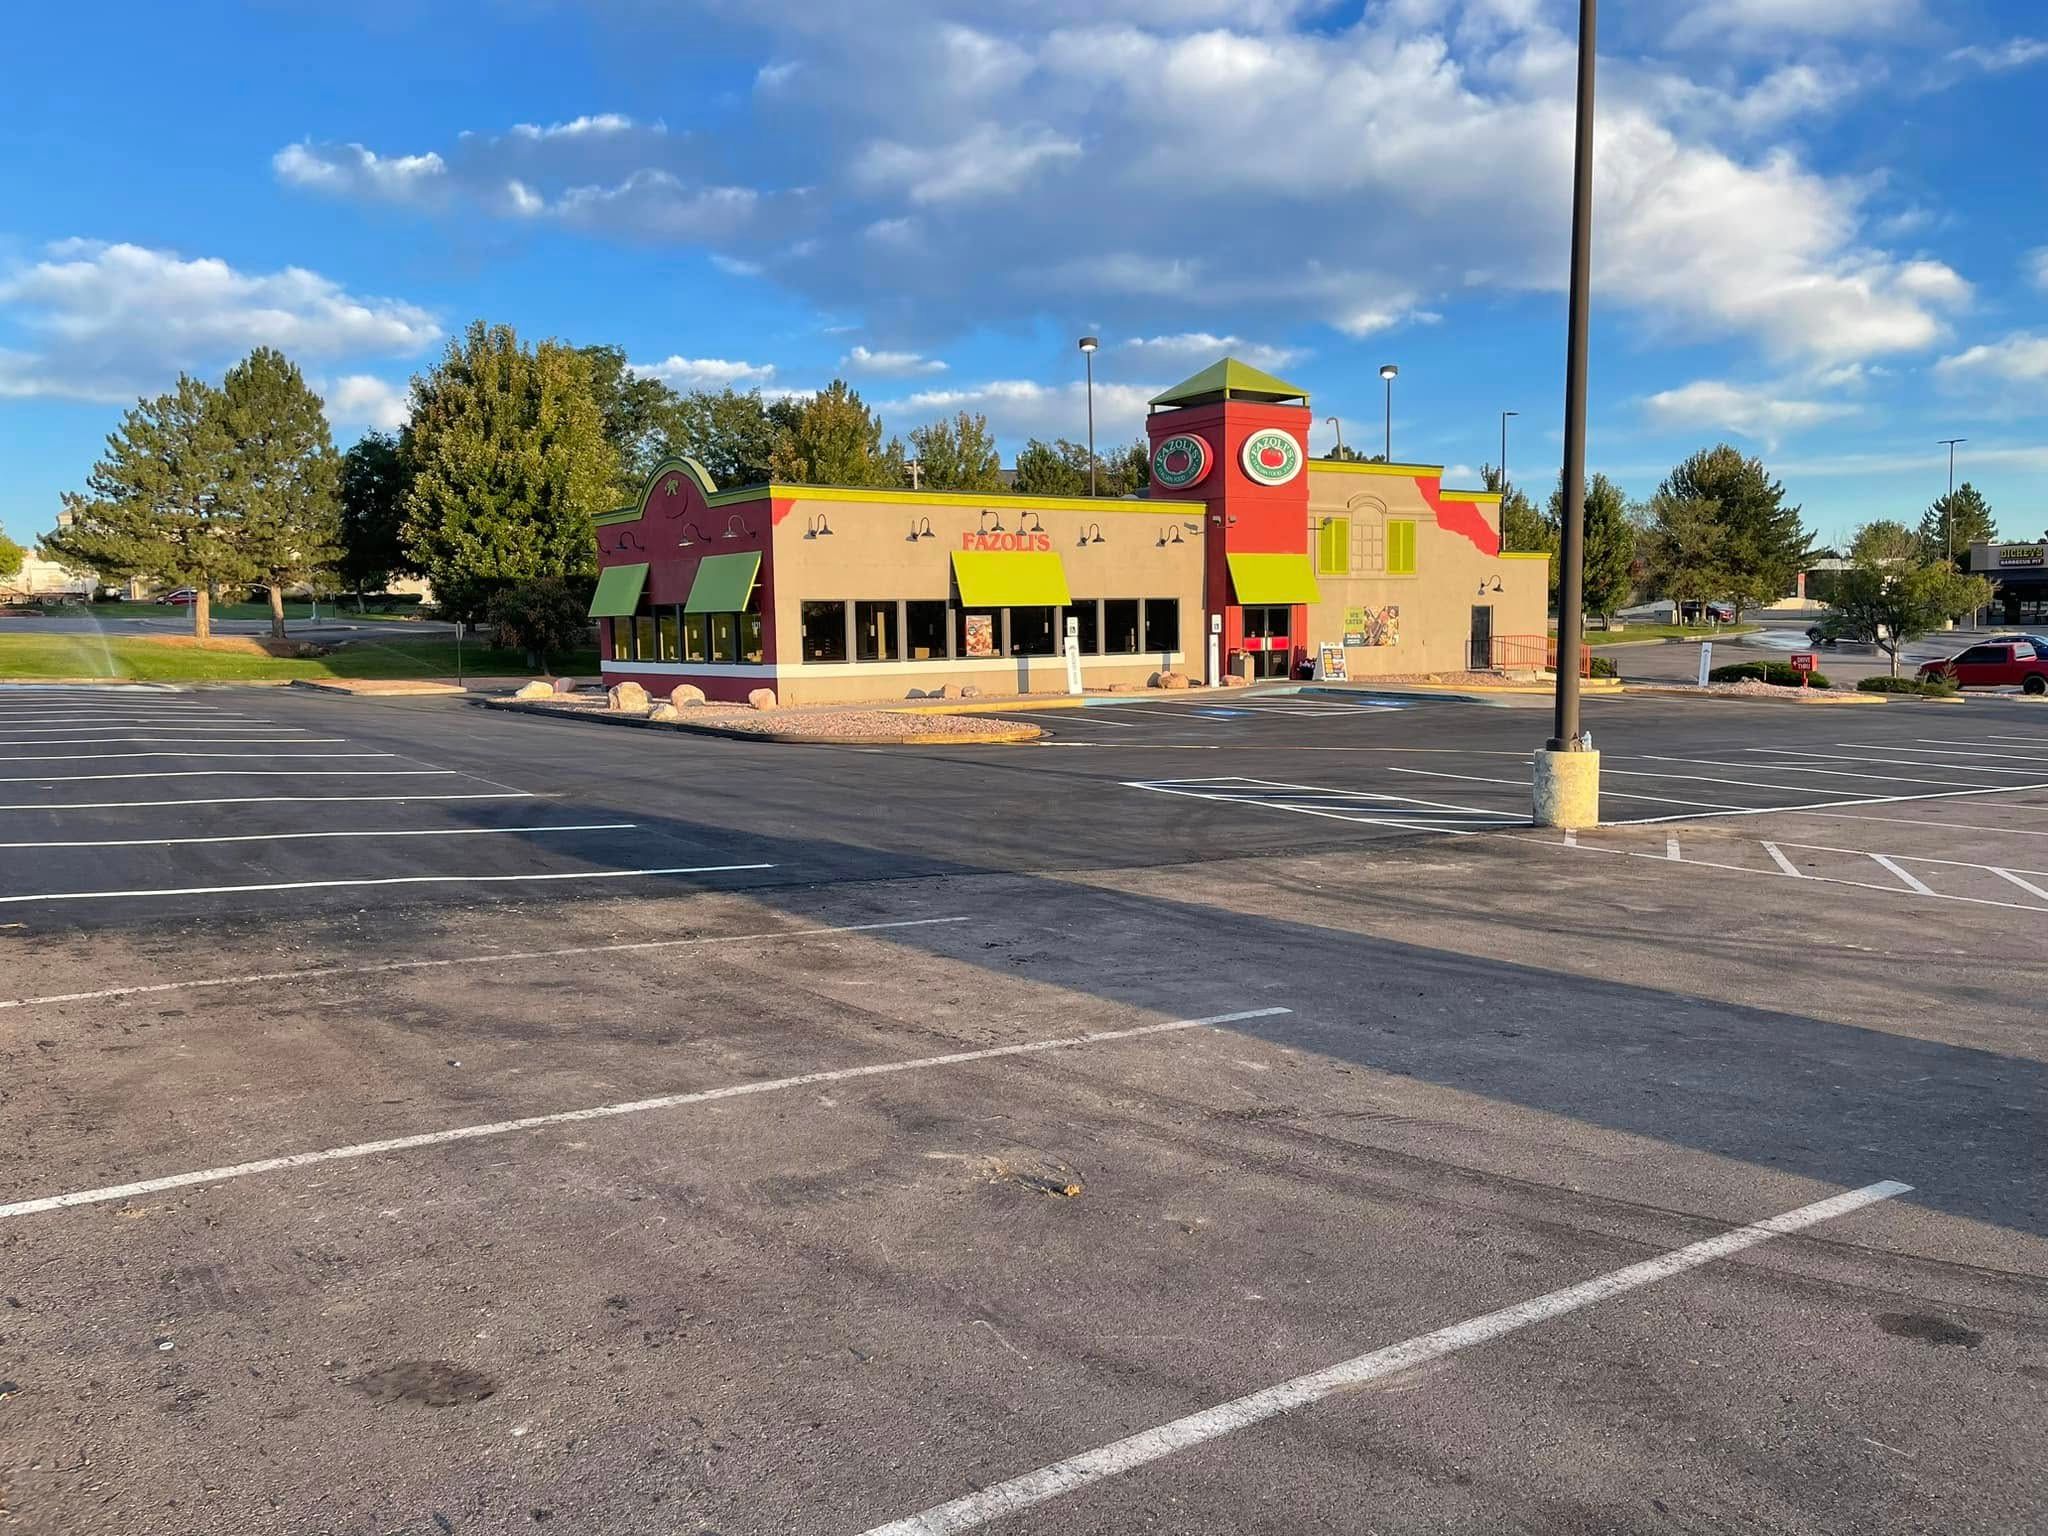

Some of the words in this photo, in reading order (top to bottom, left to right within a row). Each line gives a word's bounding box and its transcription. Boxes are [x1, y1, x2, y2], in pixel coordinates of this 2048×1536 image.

[1156, 439, 1200, 463] FAZOLI'S
[1250, 437, 1294, 458] FAZOLI'S
[962, 532, 1050, 551] FAZOLI'S
[2000, 547, 2043, 558] DICKEY'S
